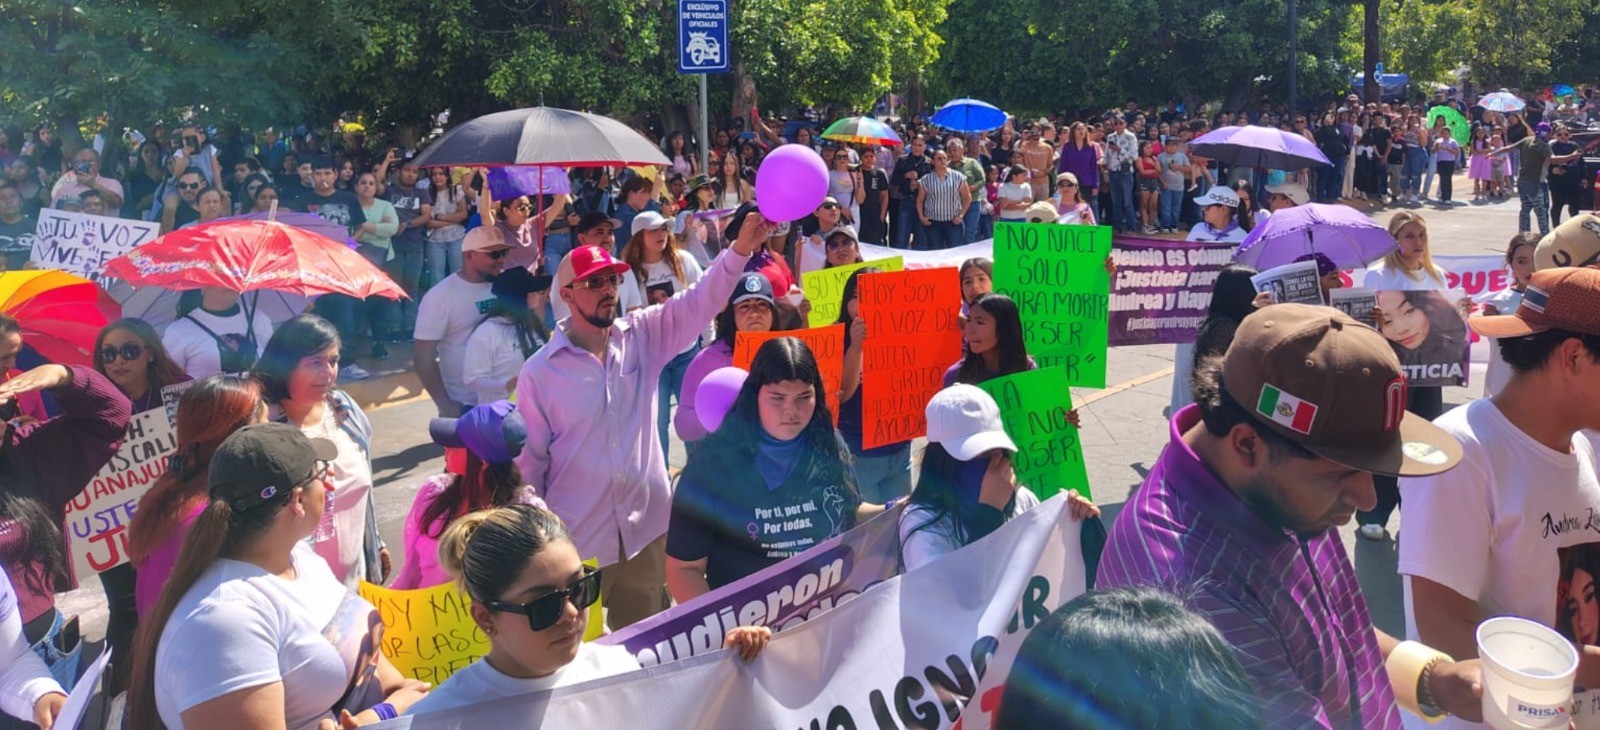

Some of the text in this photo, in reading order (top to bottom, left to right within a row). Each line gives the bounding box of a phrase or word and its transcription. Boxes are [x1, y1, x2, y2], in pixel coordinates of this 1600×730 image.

[1210, 193, 1238, 206] adidas
[49, 216, 150, 248] TU VOZ
[1018, 254, 1069, 287] SOLO
[1166, 249, 1186, 267] es
[808, 275, 829, 300] SU
[1188, 271, 1219, 288] par
[890, 309, 927, 335] VOZ
[1041, 320, 1084, 347] SER
[1400, 362, 1464, 380] STICIA
[1028, 405, 1068, 436] NO
[1029, 436, 1078, 467] SER
[755, 507, 773, 520] Por
[785, 504, 802, 517] por
[764, 522, 781, 534] Por
[416, 629, 471, 661] LAS
[1518, 704, 1560, 717] PRISA
